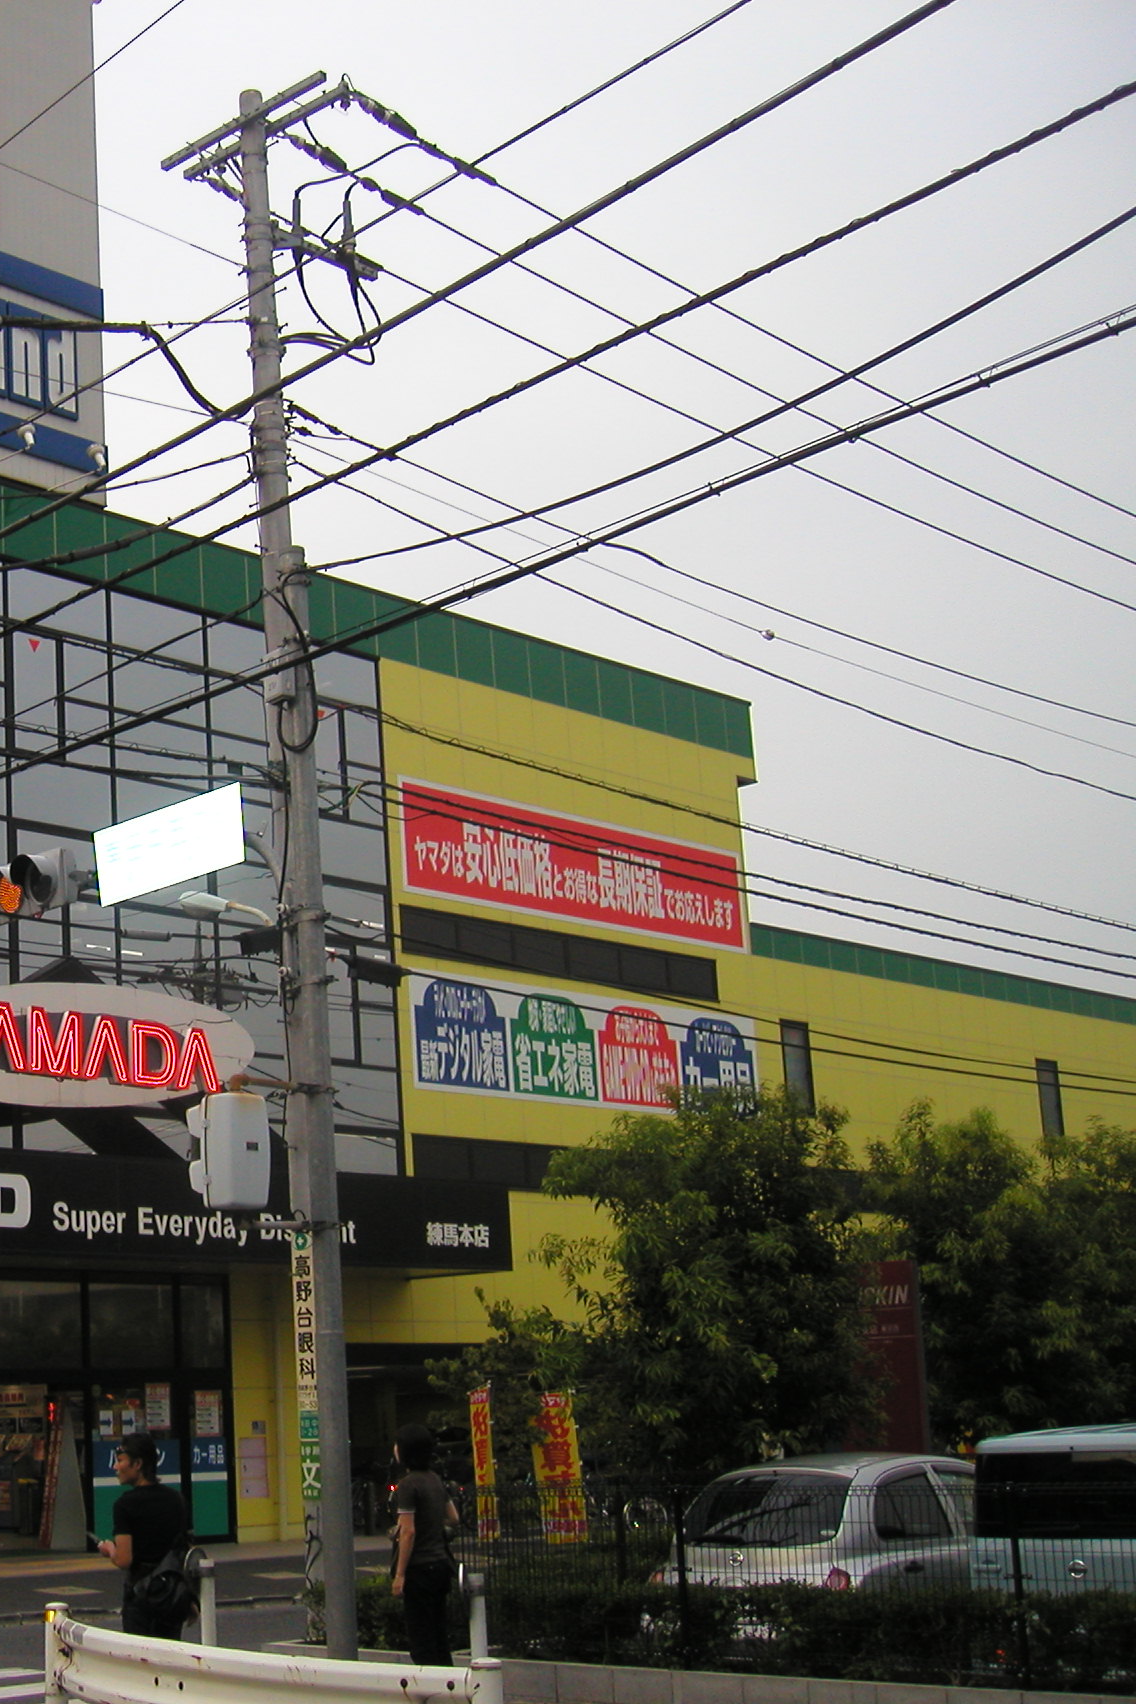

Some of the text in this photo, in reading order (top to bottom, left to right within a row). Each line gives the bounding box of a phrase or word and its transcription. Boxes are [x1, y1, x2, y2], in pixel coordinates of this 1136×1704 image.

[515, 1031, 596, 1098] 省エネ家電
[52, 1201, 127, 1240] Super
[426, 1221, 490, 1248] 練馬本店
[294, 1254, 316, 1380] 高野台眼科
[192, 1444, 225, 1466] カー用品
[301, 1458, 322, 1489] 文
